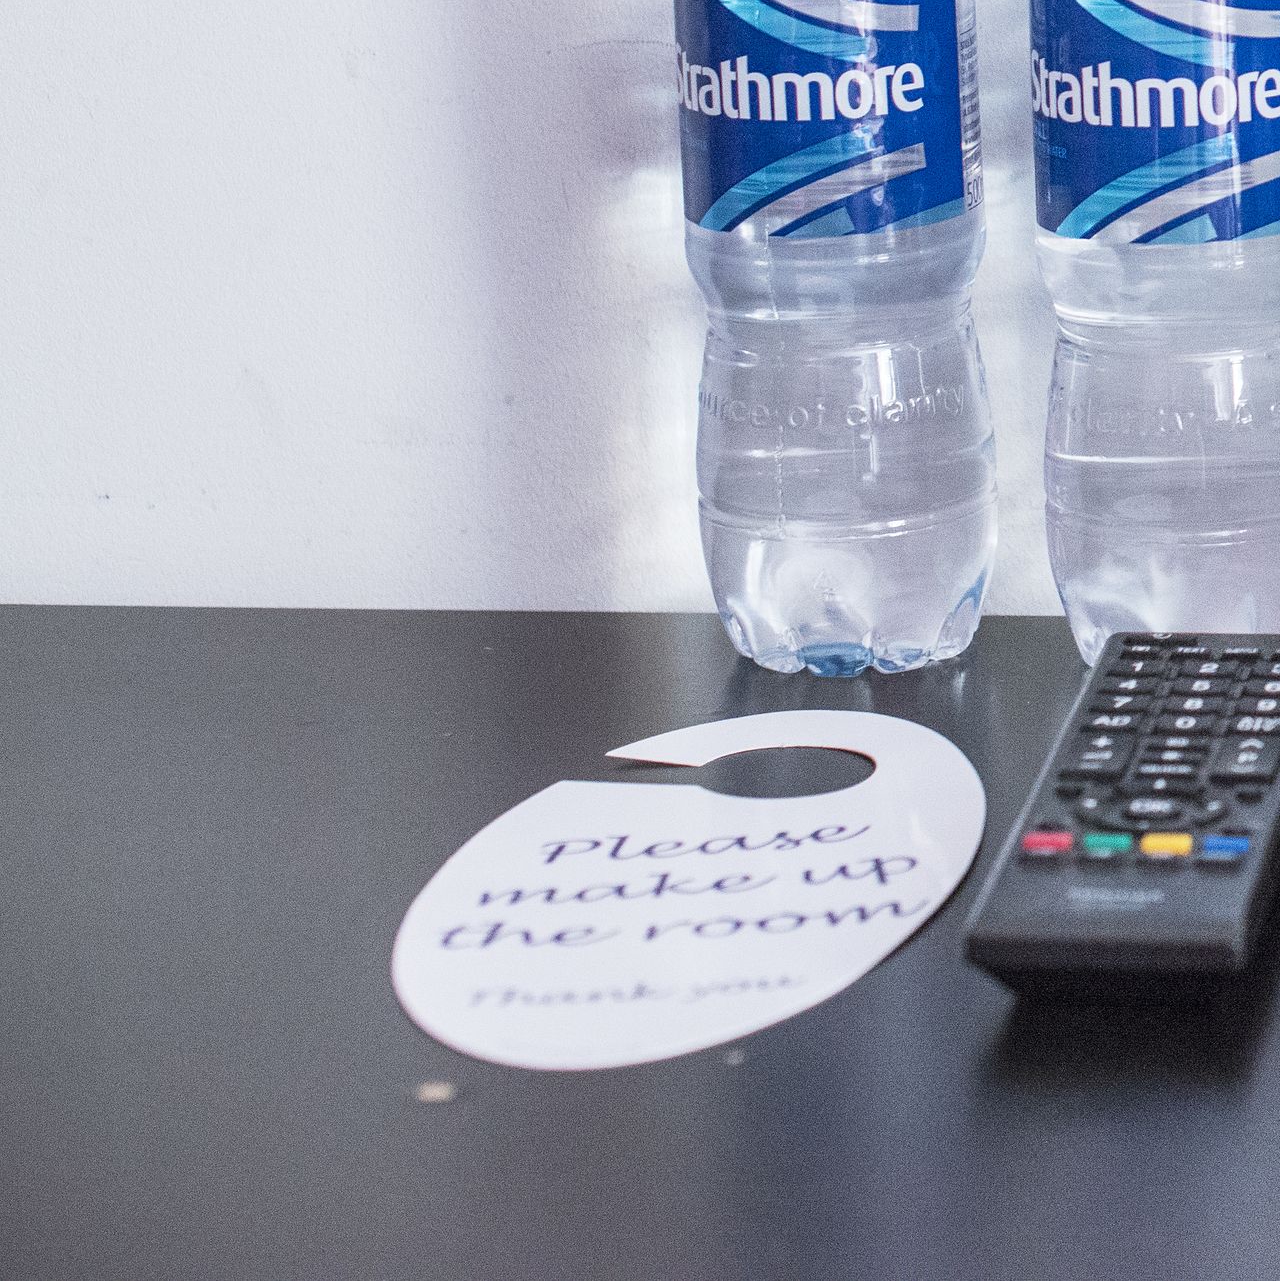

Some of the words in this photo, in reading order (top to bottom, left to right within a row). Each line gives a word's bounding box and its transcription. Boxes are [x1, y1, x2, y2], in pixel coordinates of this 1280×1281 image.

[1131, 661, 1145, 673] 1
[1199, 663, 1219, 674] 2
[1118, 679, 1138, 691] 4
[1113, 696, 1133, 709] 7
[543, 823, 871, 865] Please
[478, 871, 777, 907] make
[802, 855, 918, 886] up
[441, 921, 621, 950] the
[645, 900, 928, 941] room
